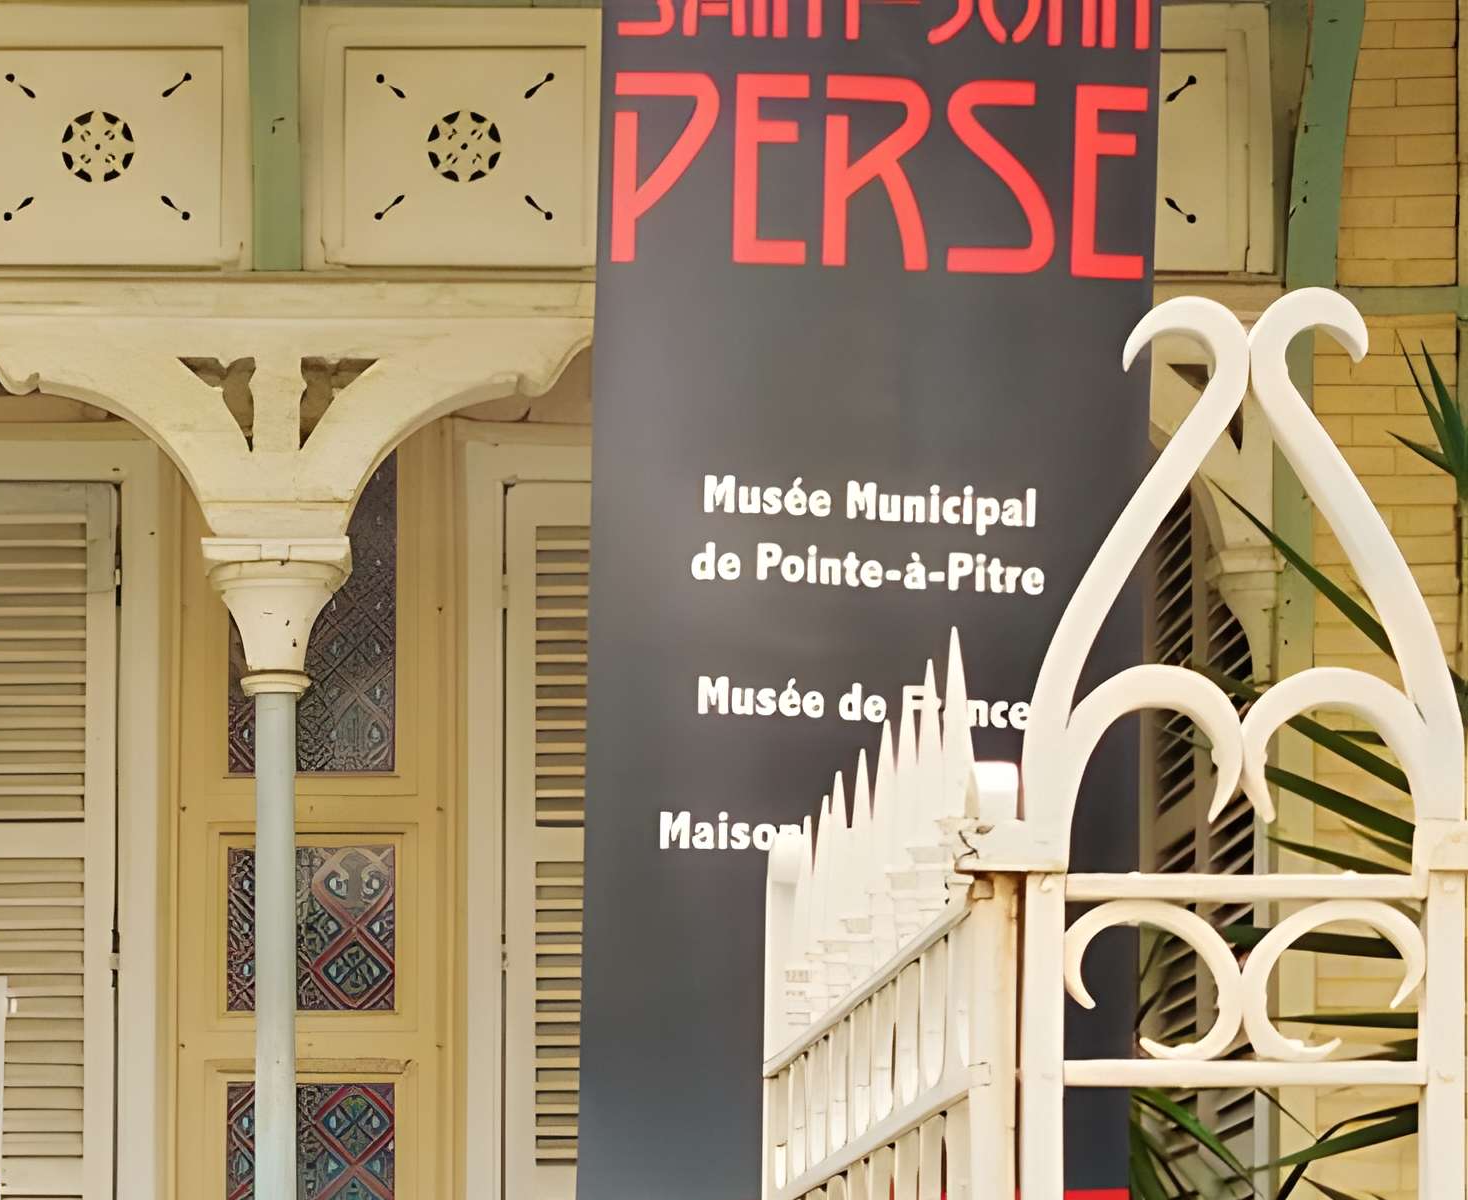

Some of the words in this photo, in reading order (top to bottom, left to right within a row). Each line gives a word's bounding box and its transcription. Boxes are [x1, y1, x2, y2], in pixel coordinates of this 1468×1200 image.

[610, 71, 1149, 280] PERSE
[703, 474, 832, 517] Musée
[846, 480, 1037, 536] Municipal
[691, 542, 741, 581] de
[756, 542, 1045, 595] Pointe-à-Pitre
[697, 675, 824, 718] Musée
[839, 683, 887, 723] de
[902, 685, 1032, 730] Fnce
